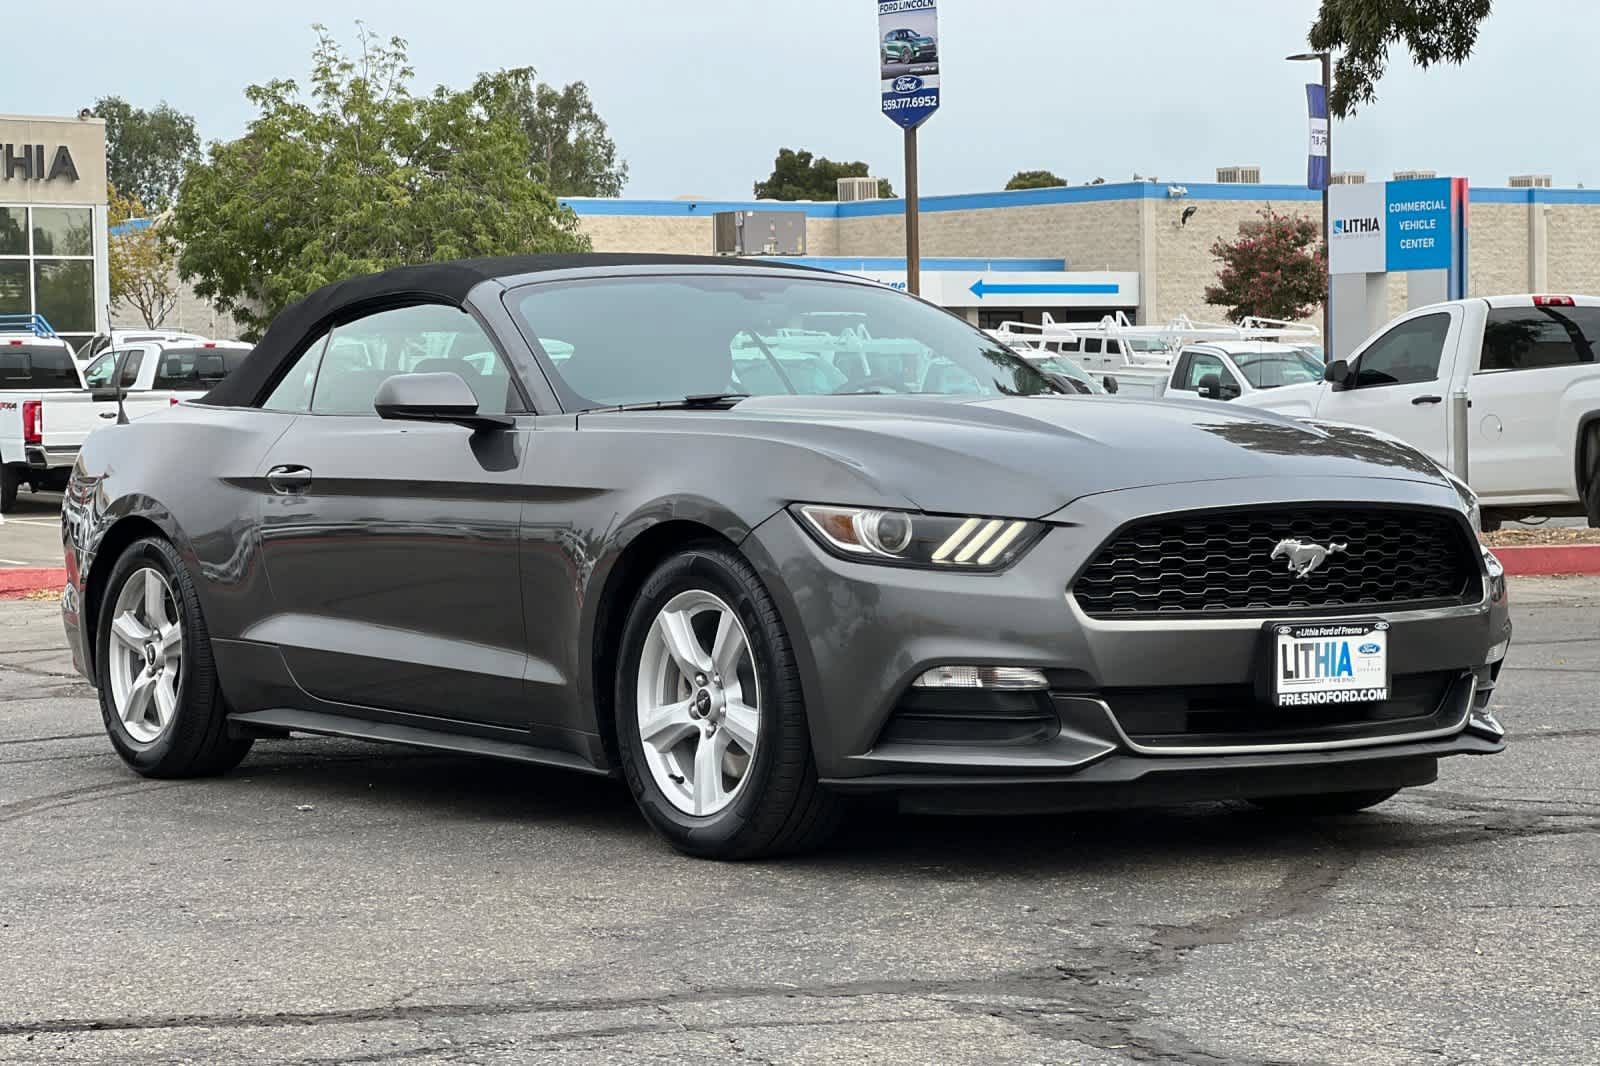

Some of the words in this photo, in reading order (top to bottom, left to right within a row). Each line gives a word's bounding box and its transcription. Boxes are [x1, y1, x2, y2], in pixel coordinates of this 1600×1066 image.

[880, 2, 898, 12] FORD
[899, 0, 934, 9] LINCOLN
[883, 96, 937, 110] 559.777.6952
[0, 144, 80, 182] HIA
[1389, 200, 1446, 213] COMMERCIAL
[1343, 217, 1380, 233] LITHIA
[1399, 219, 1436, 230] VEHICLE
[1400, 238, 1434, 249] CENTER
[1301, 629, 1319, 637] Lithia
[1320, 628, 1333, 636] Ford
[1342, 626, 1362, 635] Fresno
[1282, 641, 1353, 680] LITHIA
[1279, 688, 1387, 706] FRESNOFORD.COM
